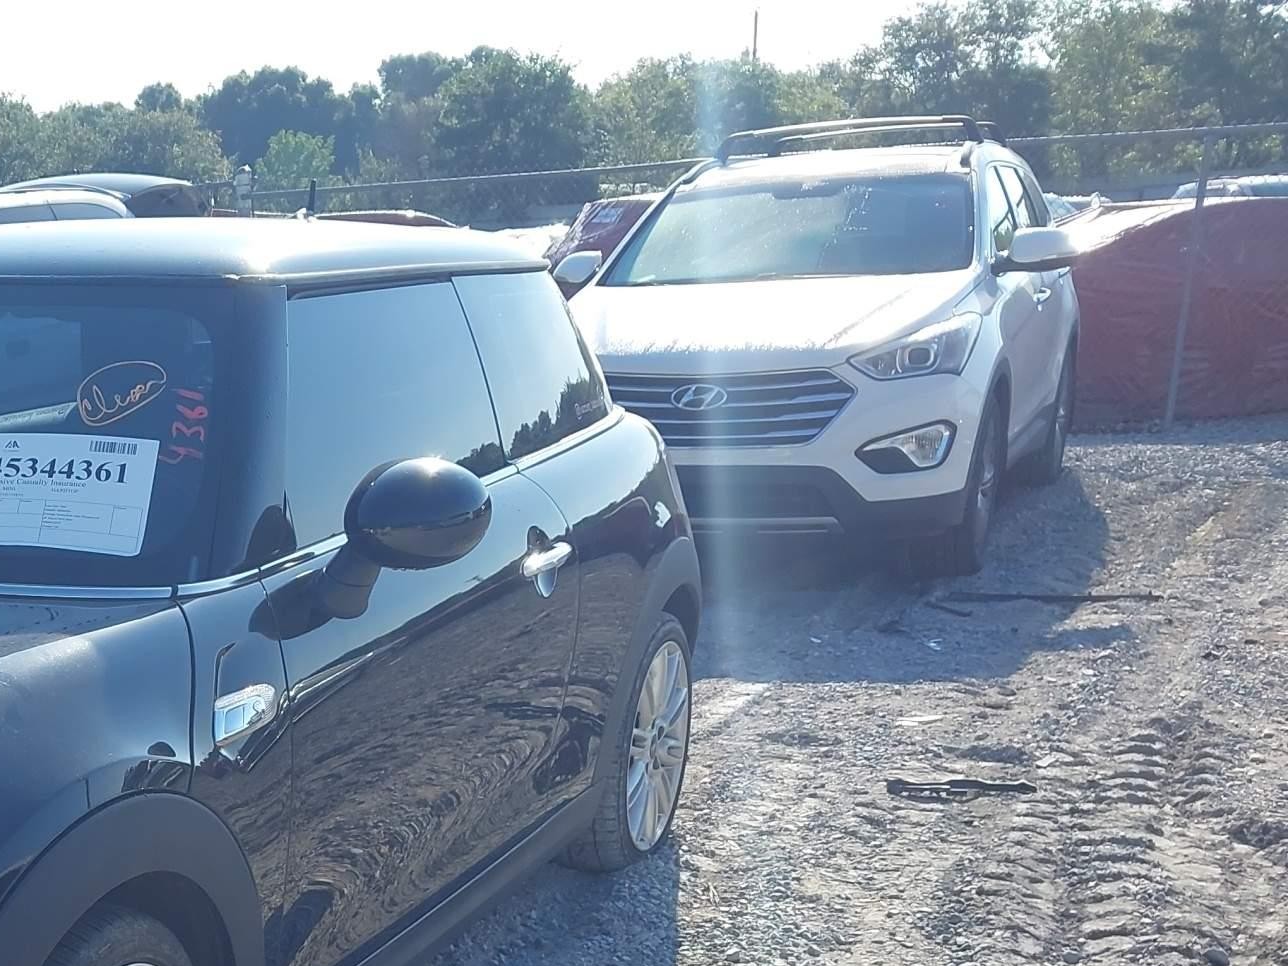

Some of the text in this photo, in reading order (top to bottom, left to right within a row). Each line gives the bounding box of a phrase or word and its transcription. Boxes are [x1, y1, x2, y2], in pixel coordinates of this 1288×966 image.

[158, 388, 208, 464] 4361
[16, 478, 48, 487] Casualty
[50, 479, 87, 488] Insurance
